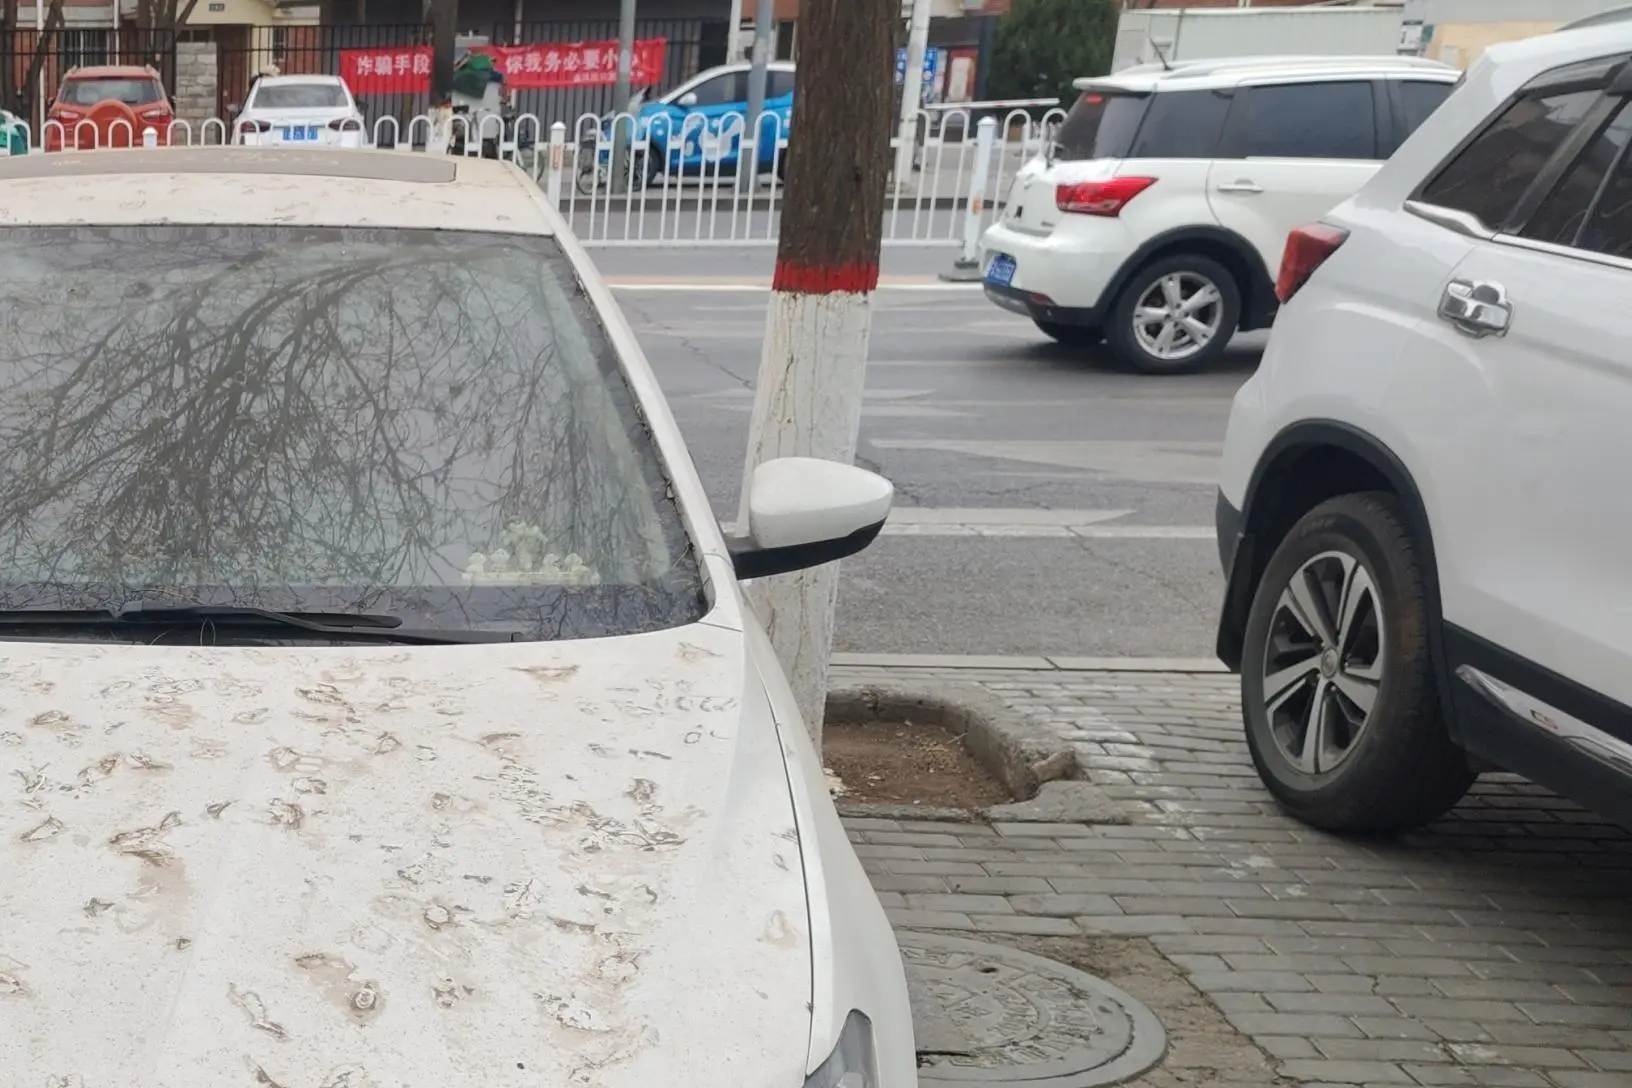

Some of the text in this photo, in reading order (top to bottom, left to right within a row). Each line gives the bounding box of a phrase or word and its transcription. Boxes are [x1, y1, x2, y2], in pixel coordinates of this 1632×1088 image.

[357, 48, 647, 76] 诈骗手段 你我务必要小!
